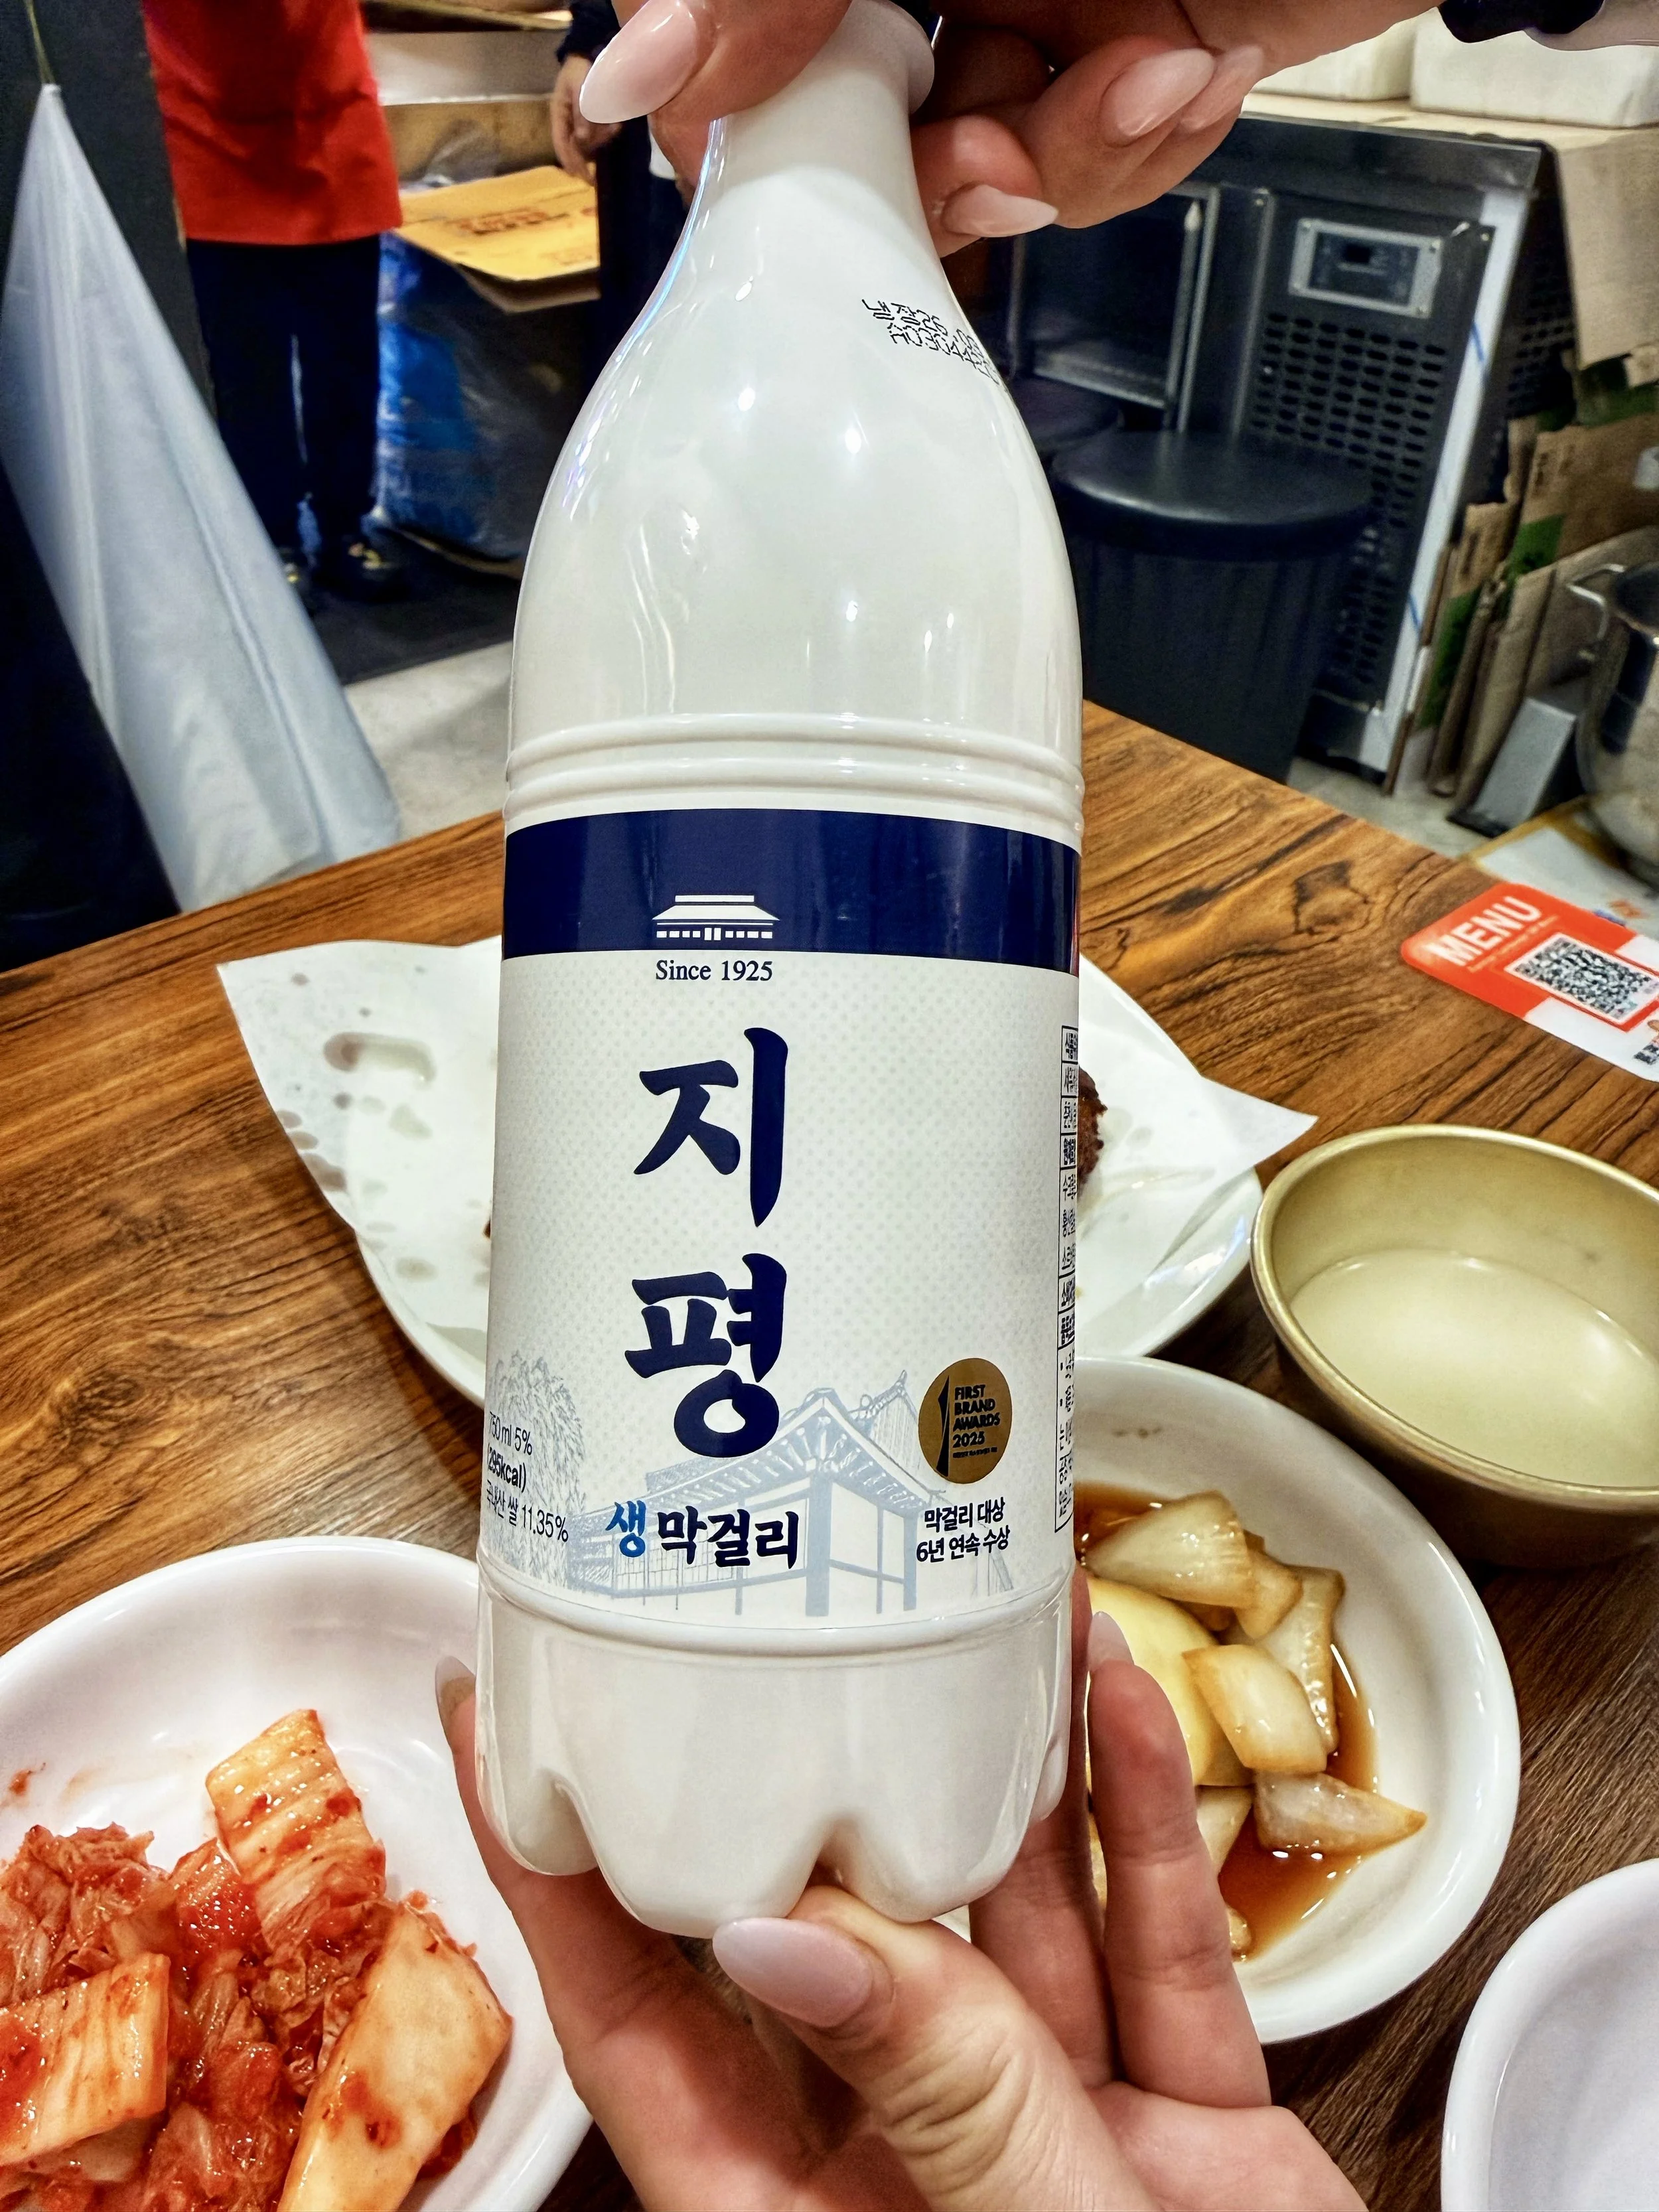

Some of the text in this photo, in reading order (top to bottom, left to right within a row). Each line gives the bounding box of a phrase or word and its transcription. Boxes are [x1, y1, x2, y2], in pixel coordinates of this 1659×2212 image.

[1424, 895, 1542, 967] MENU
[656, 960, 773, 981] Since 1925
[954, 1384, 986, 1400] FIRST
[954, 1398, 995, 1416] BRAND
[952, 1412, 1001, 1432] AWARDS
[514, 1427, 532, 1455] 5%
[522, 1503, 569, 1543] 11.35%
[924, 1497, 1006, 1533] 막걸리 대상
[916, 1524, 1011, 1563] 6년 연속 수상
